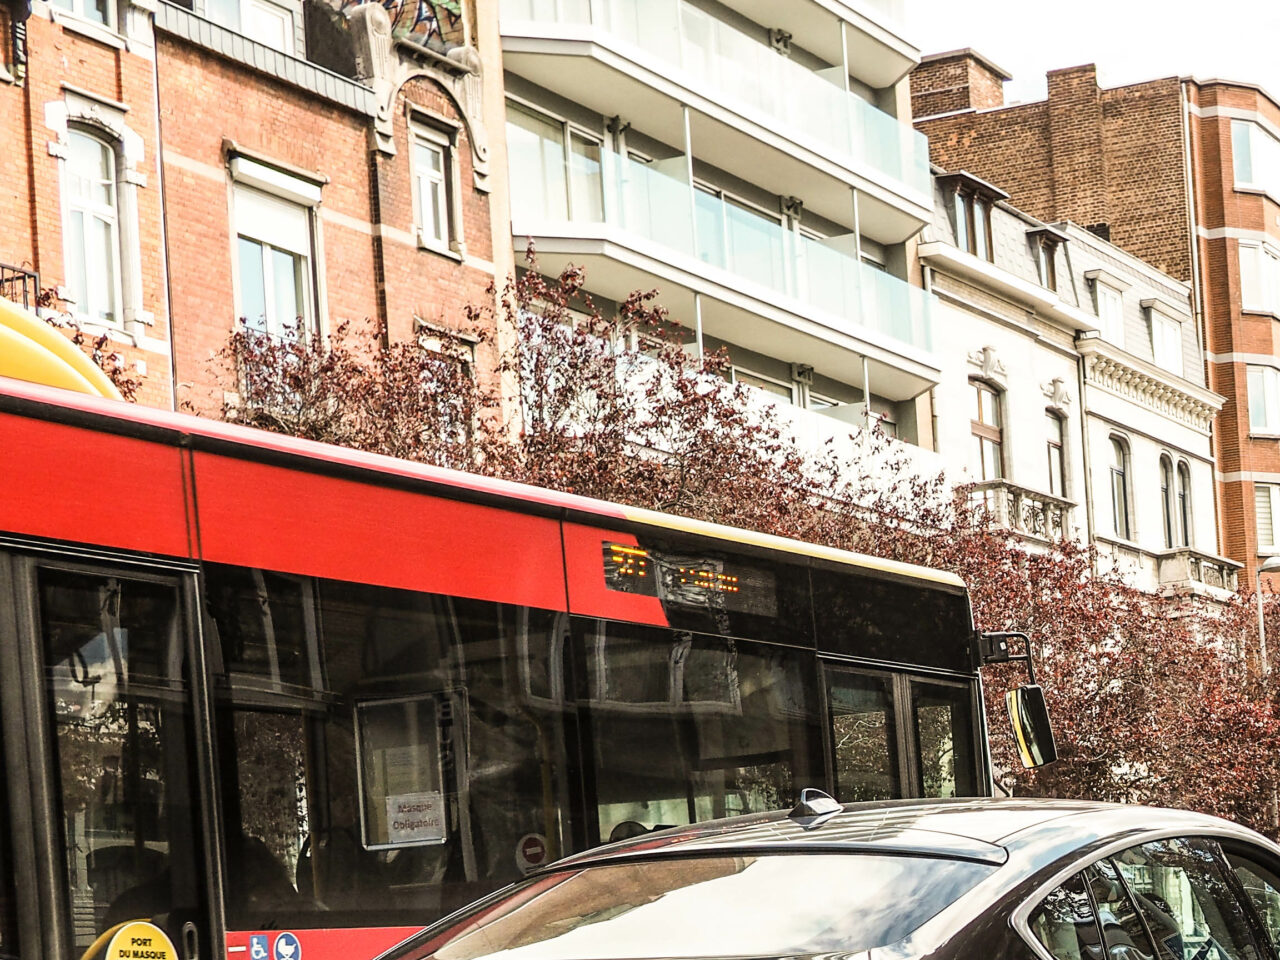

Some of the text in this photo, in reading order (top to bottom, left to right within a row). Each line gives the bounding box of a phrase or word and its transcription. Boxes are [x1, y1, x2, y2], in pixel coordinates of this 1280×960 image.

[397, 803, 432, 813] Masque
[393, 819, 440, 831] Obligatoire
[131, 938, 152, 946] PORT
[119, 950, 166, 959] DU MASQUE
